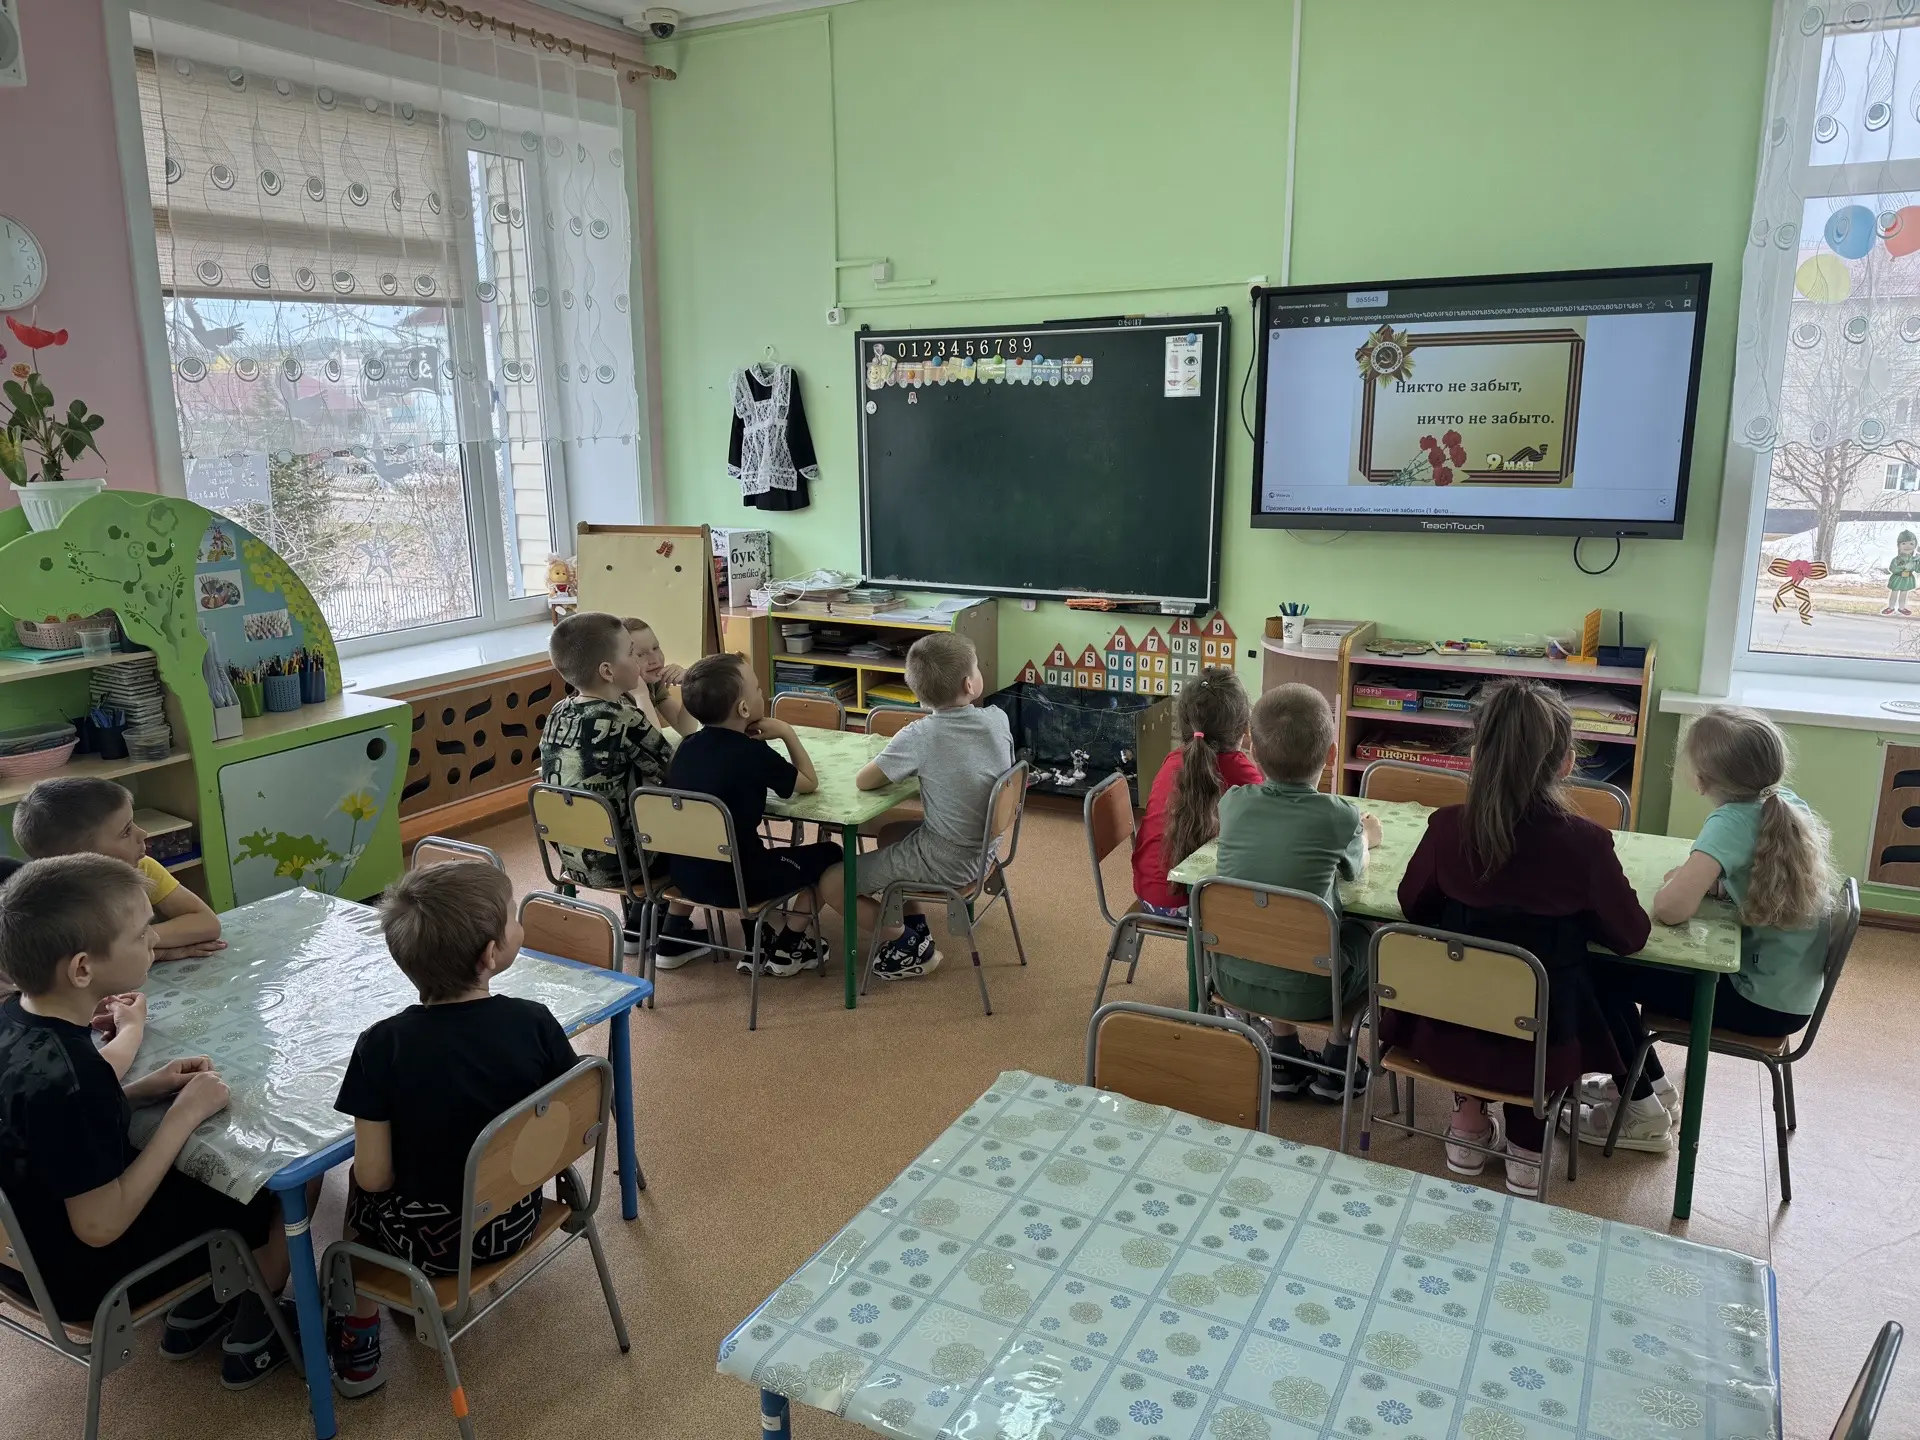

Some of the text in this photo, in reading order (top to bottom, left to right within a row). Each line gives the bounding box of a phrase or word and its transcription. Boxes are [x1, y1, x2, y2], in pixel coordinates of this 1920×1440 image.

[17, 238, 28, 253] 2
[27, 256, 36, 271] 3
[23, 274, 33, 288] 4
[12, 285, 22, 299] 5
[899, 338, 1032, 357] 0 1 2 3 4 5 6 7 8 9
[1395, 378, 1522, 394] Никто не забыт,
[1417, 411, 1555, 425] ничто не забыто.
[1486, 453, 1503, 471] 9
[1421, 521, 1485, 530] TeachTouch
[1182, 621, 1188, 631] 8
[1215, 622, 1221, 632] 9
[1117, 638, 1123, 648] 6
[1150, 639, 1155, 648] 7
[1175, 641, 1196, 651] 0 8
[1207, 644, 1229, 655] 0 9
[1056, 653, 1063, 662] 4
[1087, 653, 1093, 663] 5
[1110, 658, 1131, 667] 0 6
[1142, 658, 1163, 670] 0 7
[1175, 662, 1179, 672] 1
[1190, 663, 1195, 673] 7
[1027, 671, 1033, 681] 3
[1050, 673, 1069, 682] 0 4
[1080, 675, 1101, 684] 0 5
[1111, 679, 1131, 688] 1 5
[1143, 679, 1163, 690] 1 6
[1174, 683, 1180, 692] 2
[1356, 687, 1382, 696] ЦИФРЫ
[1376, 749, 1420, 762] ЦИФРЫ
